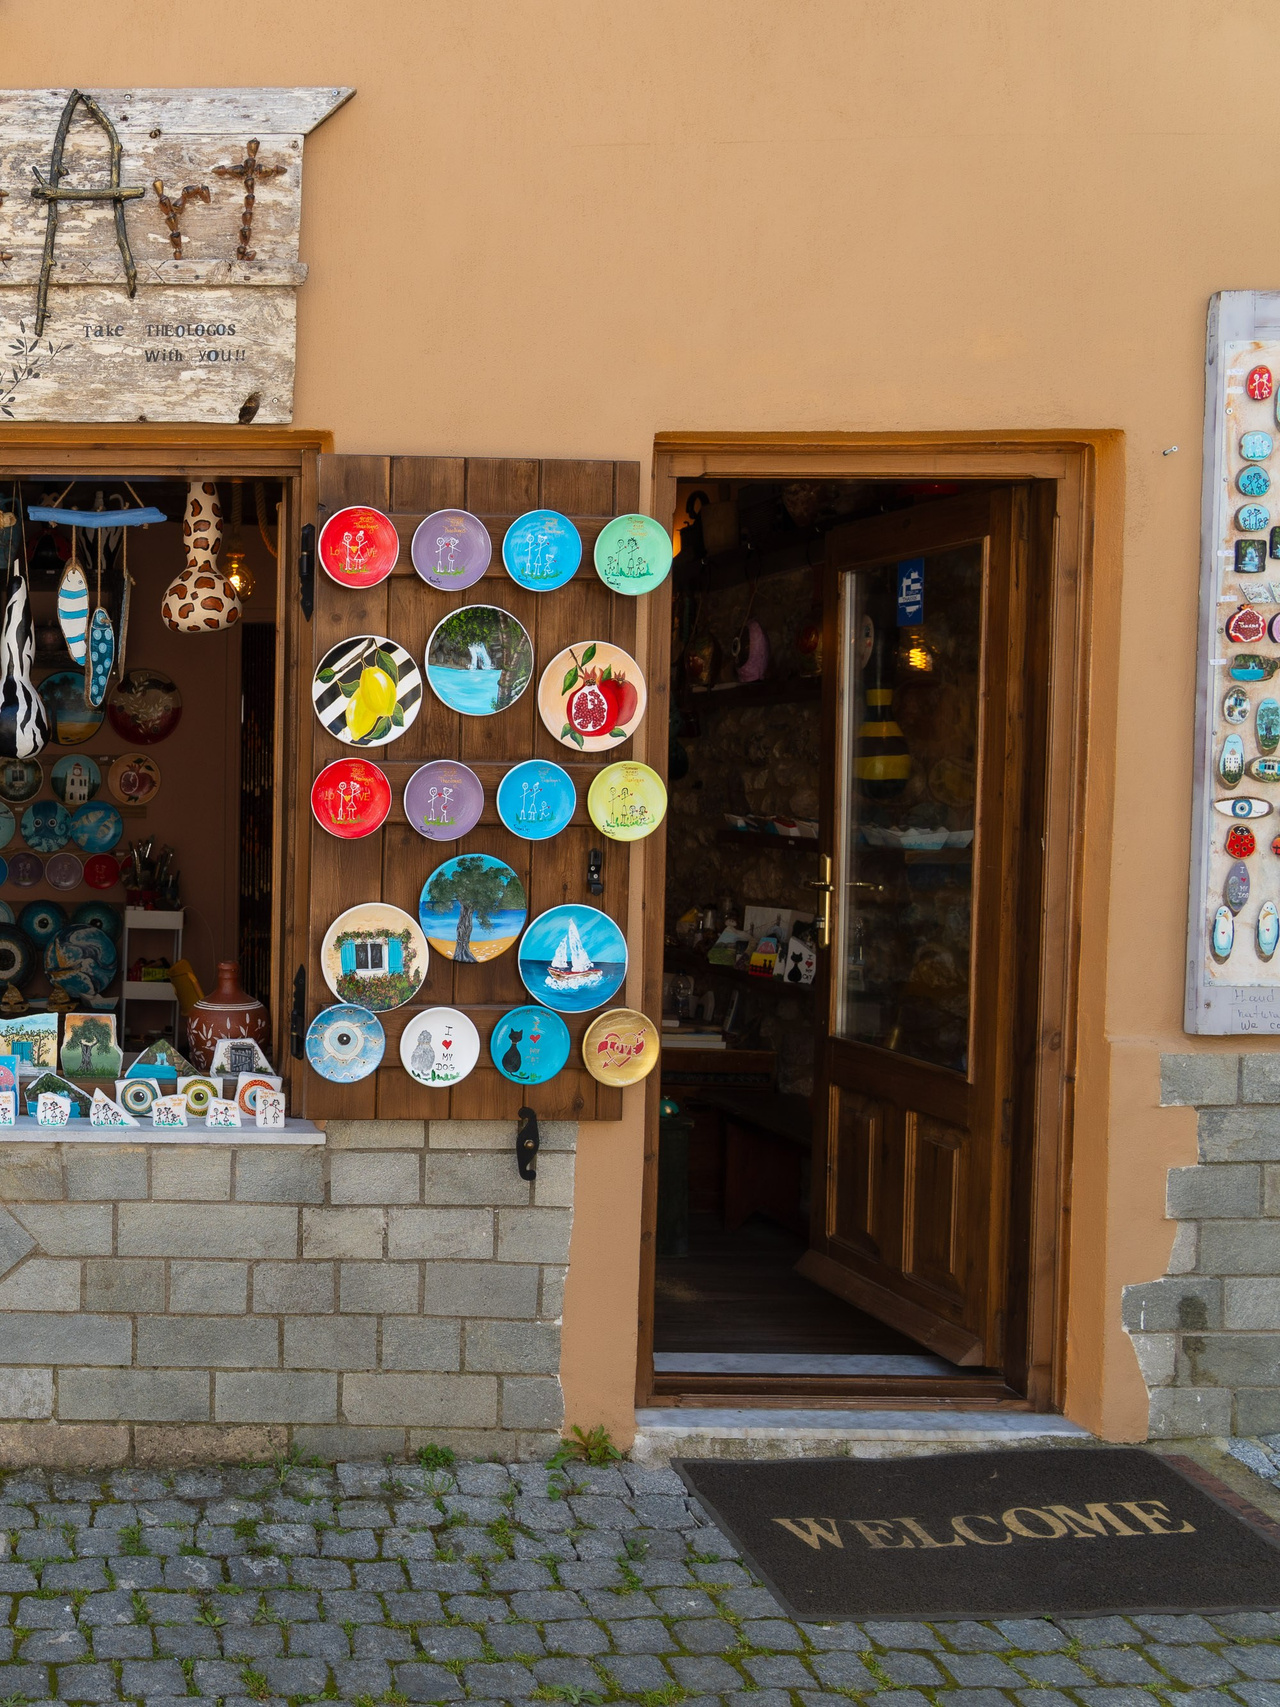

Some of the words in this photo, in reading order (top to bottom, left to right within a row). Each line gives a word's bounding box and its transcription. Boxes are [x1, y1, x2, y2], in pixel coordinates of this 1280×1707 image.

[83, 324, 124, 337] Take
[145, 323, 236, 337] THEOLOGOS
[145, 349, 183, 362] With
[445, 1025, 453, 1036] I
[441, 1053, 454, 1062] MY
[435, 1062, 456, 1071] DOG
[771, 1499, 1197, 1550] WELCOME
